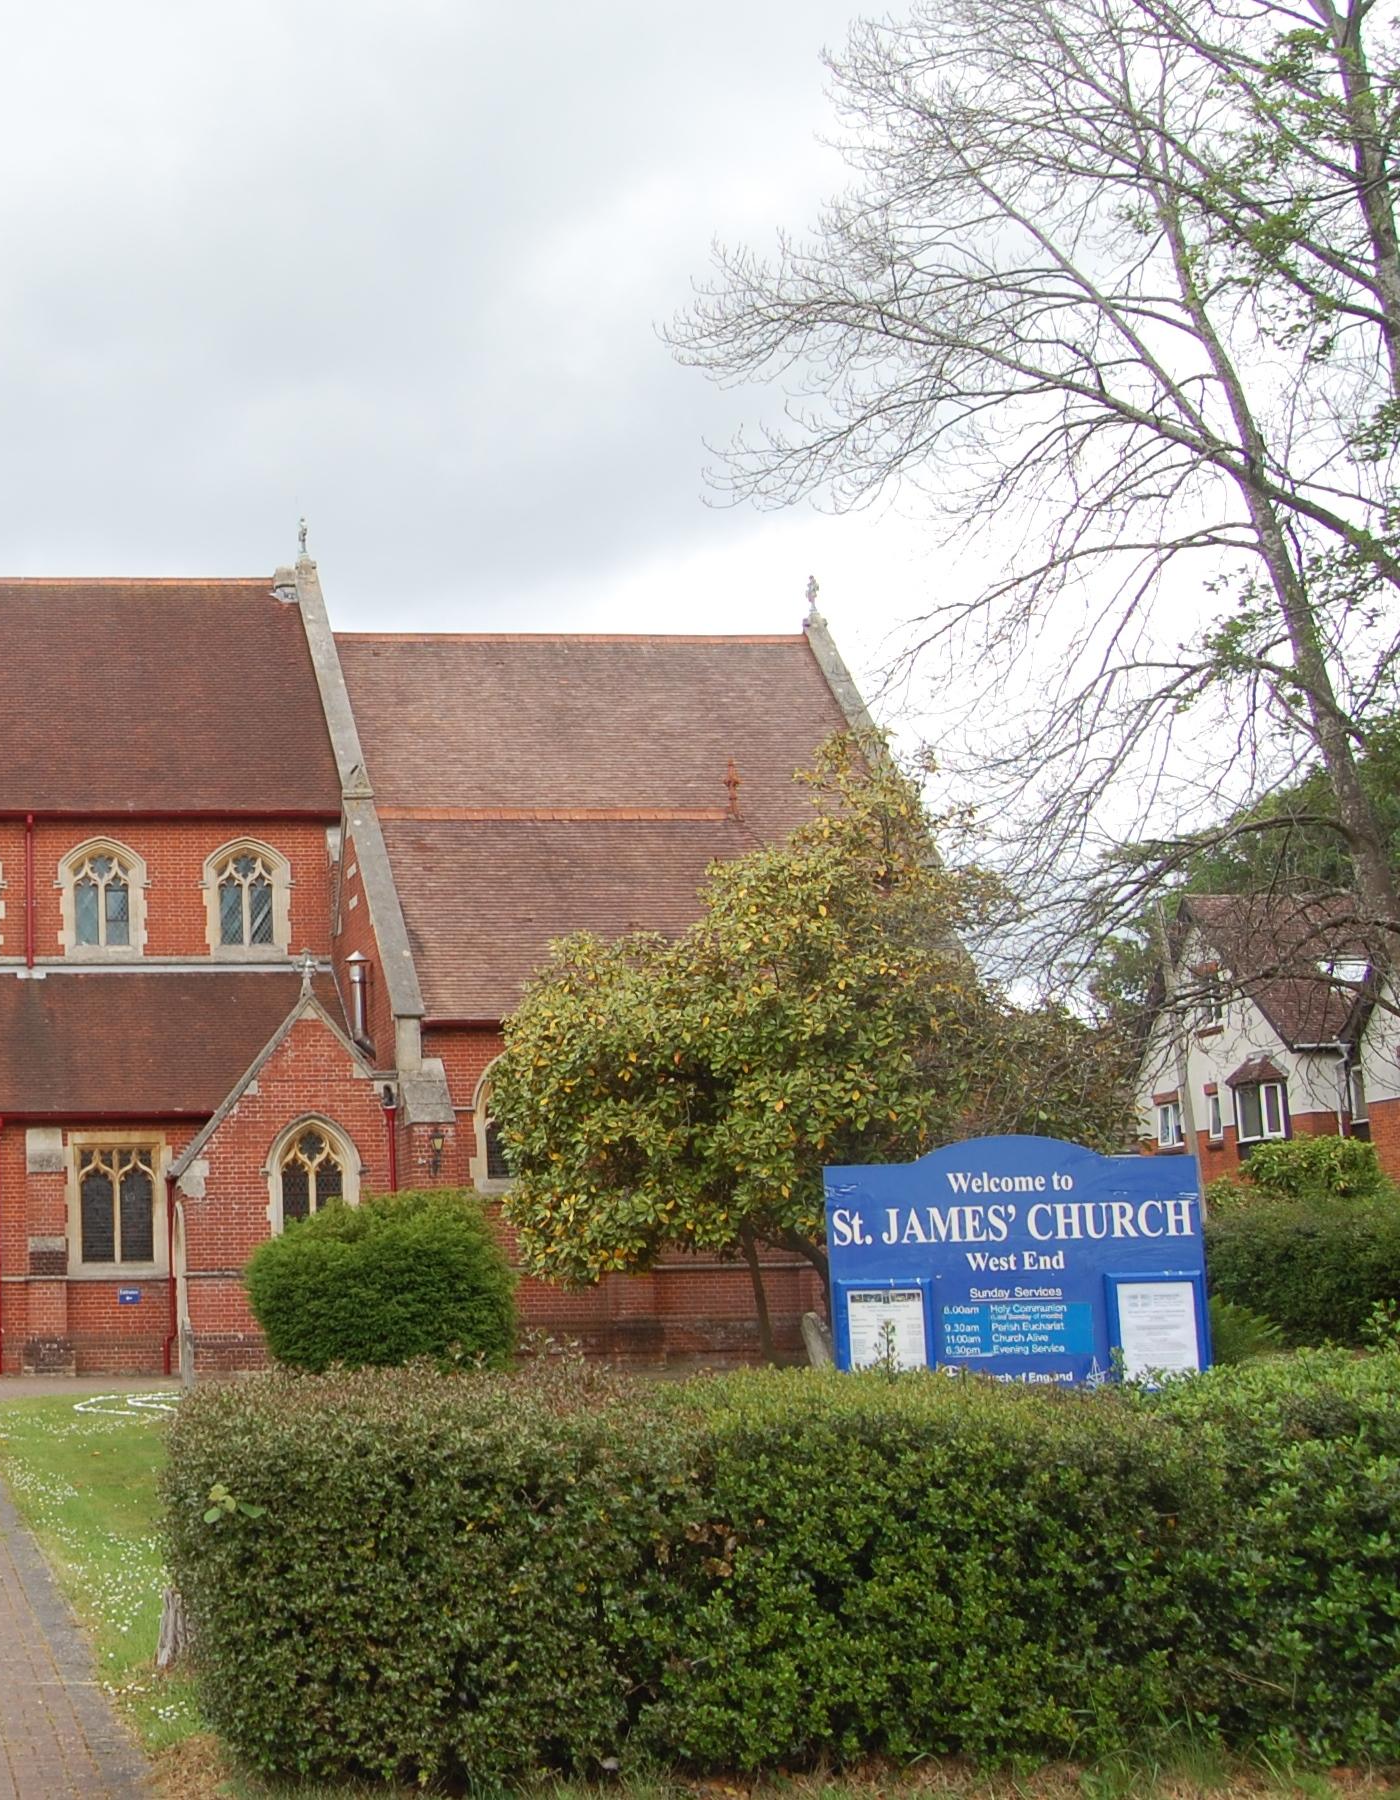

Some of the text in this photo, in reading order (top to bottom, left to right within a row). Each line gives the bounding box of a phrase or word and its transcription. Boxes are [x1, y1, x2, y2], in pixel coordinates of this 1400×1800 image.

[946, 1171, 1073, 1194] Welcome to
[832, 1199, 1195, 1247] St. JAMES’ CHURCH
[965, 1250, 1065, 1272] West End
[970, 1286, 1062, 1299] Sunday Services
[990, 1304, 1010, 1314] Holy
[1012, 1303, 1067, 1313] Communion
[991, 1322, 1020, 1332] Parish
[1022, 1321, 1065, 1331] Eucharist
[992, 1333, 1025, 1343] Church
[1026, 1333, 1049, 1342] Alive
[993, 1344, 1029, 1355] Evening
[1031, 1343, 1065, 1353] Service
